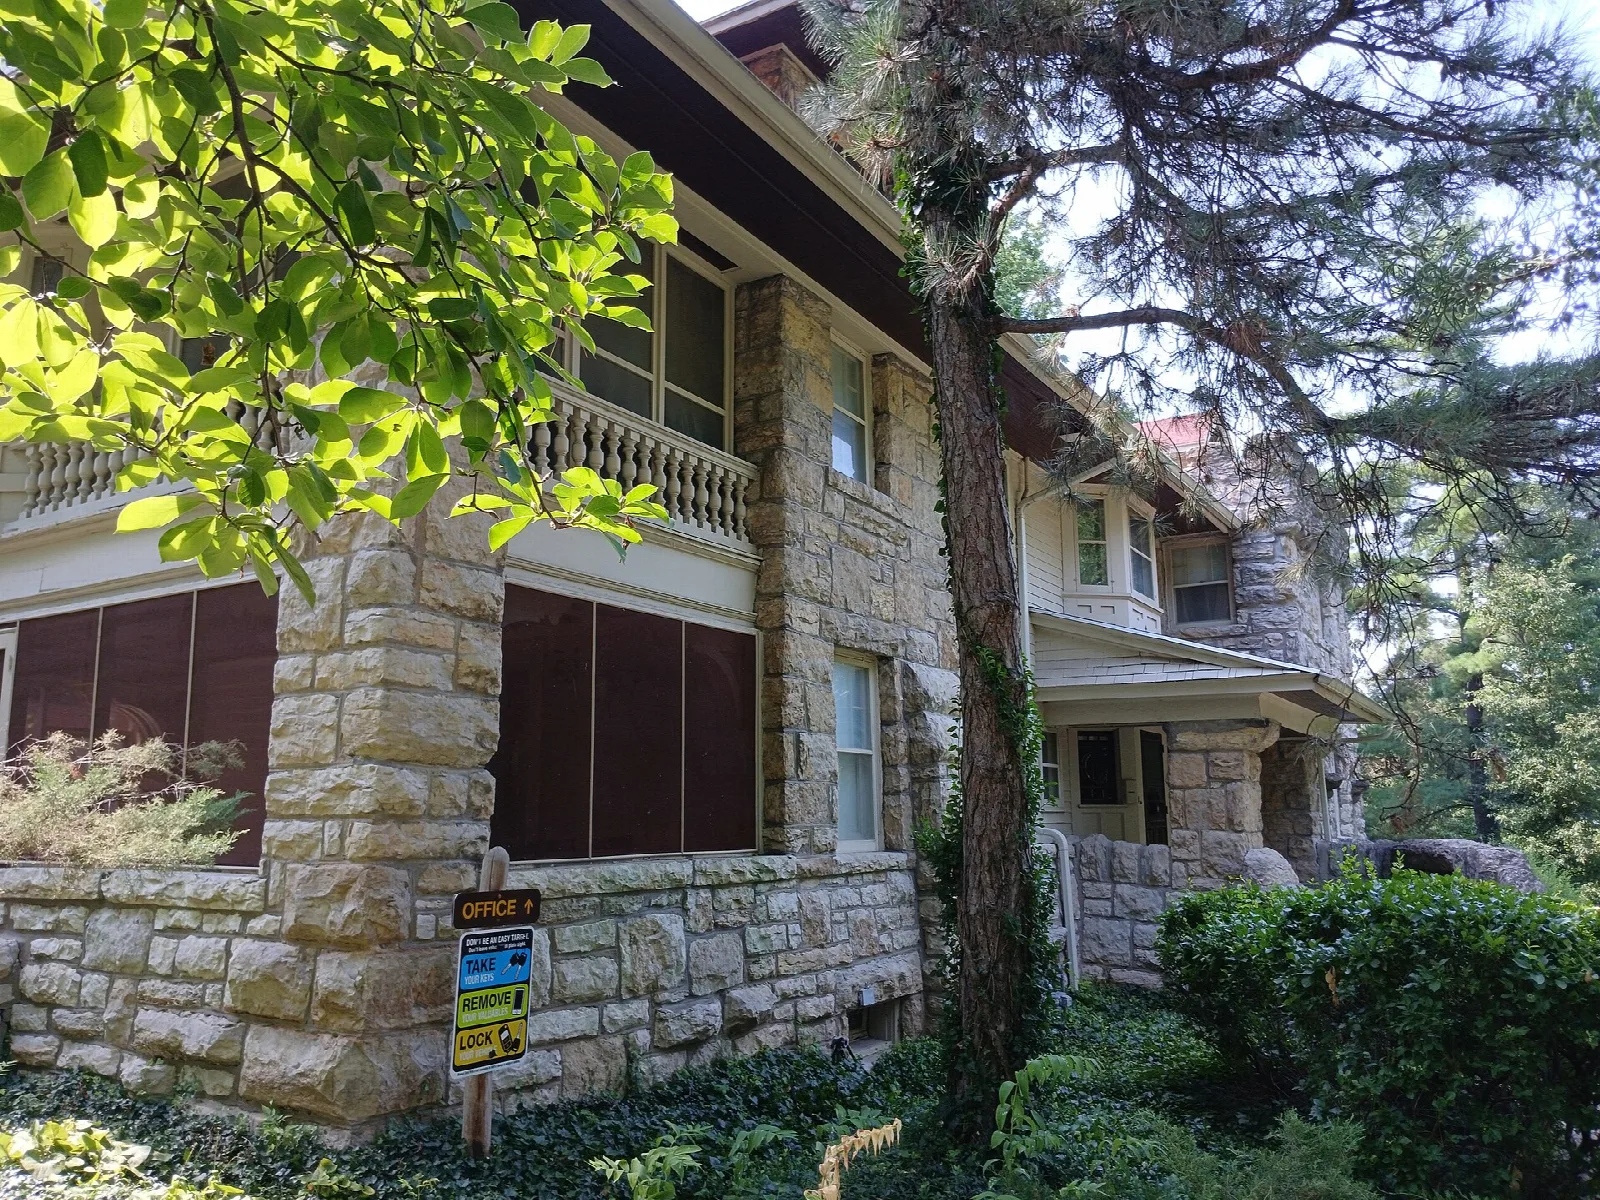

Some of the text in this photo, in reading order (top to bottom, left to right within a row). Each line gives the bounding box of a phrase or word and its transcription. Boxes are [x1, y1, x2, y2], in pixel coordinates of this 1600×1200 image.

[462, 899, 517, 920] OFFICE
[466, 937, 481, 947] DON'T
[482, 937, 489, 945] BE
[490, 936, 497, 944] AN
[497, 934, 510, 943] EASY
[466, 957, 496, 974] TAKE
[464, 973, 494, 985] YOUR KEYS
[462, 991, 511, 1012] REMOVE
[462, 1007, 508, 1023] YOUR VALUABLES
[459, 1030, 493, 1050] LOCK
